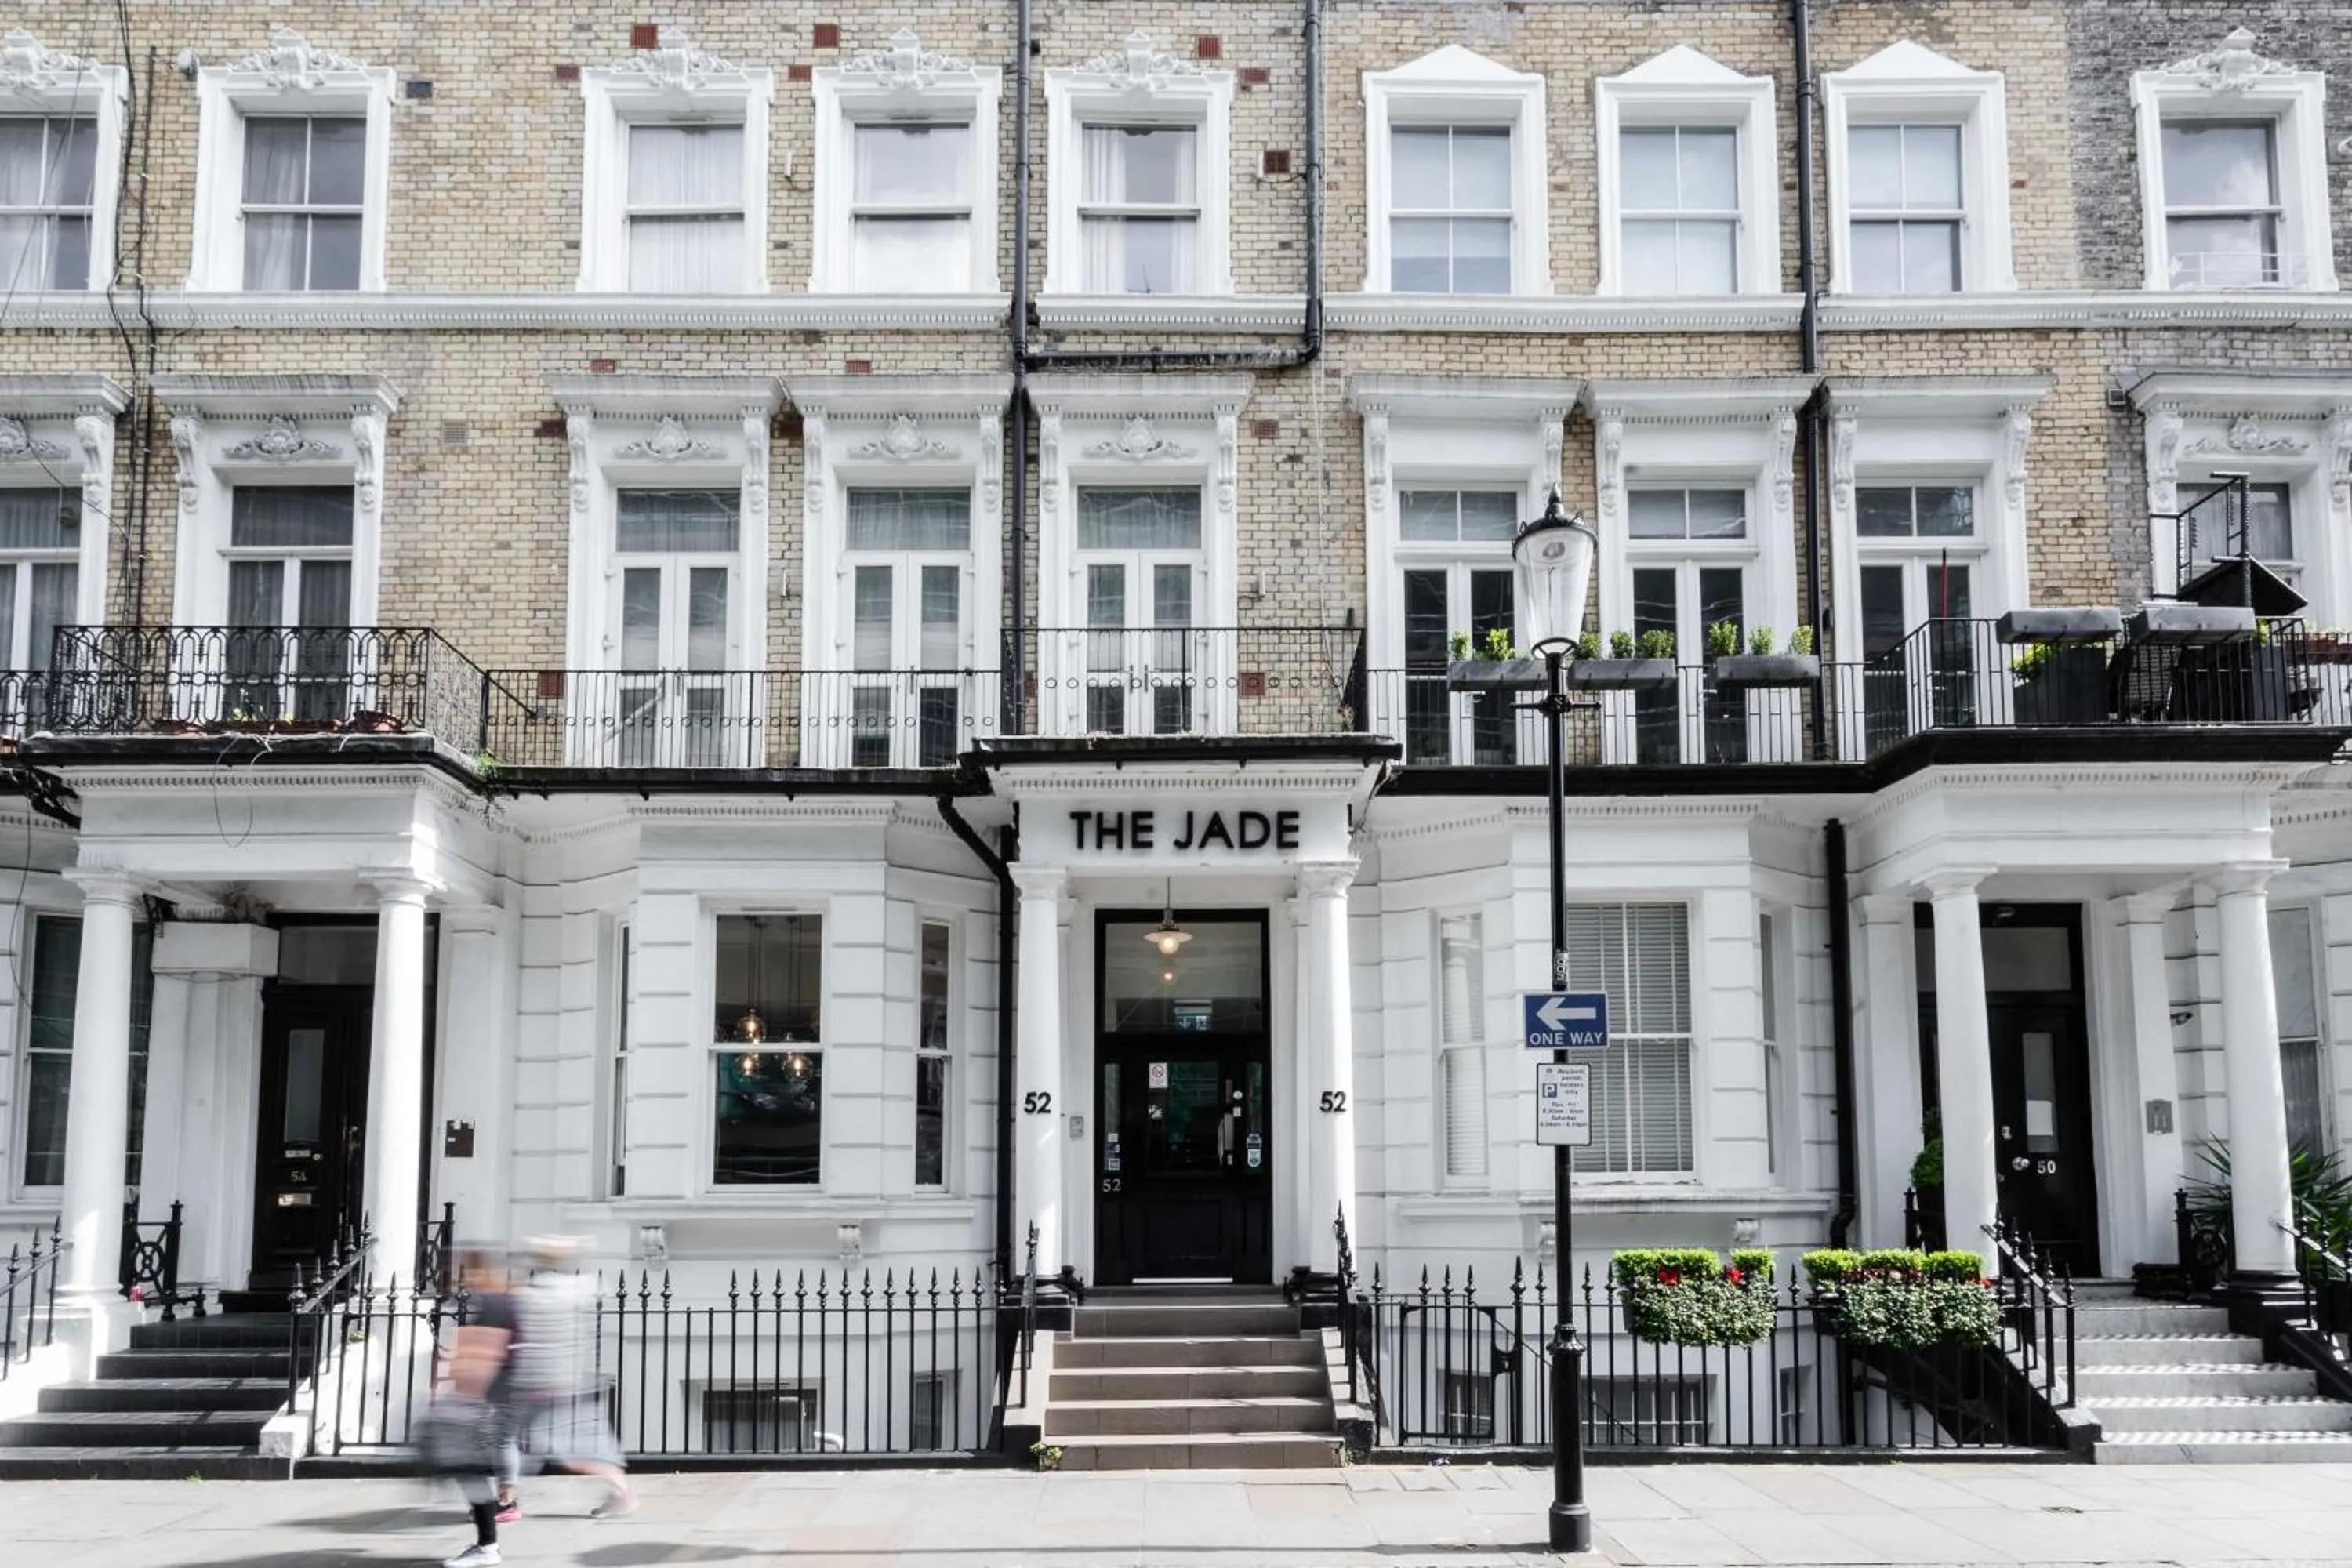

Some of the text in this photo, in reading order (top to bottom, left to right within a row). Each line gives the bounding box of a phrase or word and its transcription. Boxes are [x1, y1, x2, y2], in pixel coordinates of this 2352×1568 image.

[1069, 811, 1299, 850] THE JADE
[1530, 1031, 1604, 1045] ONE WAY
[1544, 1084, 1555, 1097] P
[1023, 1091, 1051, 1113] 52
[1319, 1091, 1347, 1113] 52
[2037, 1160, 2056, 1174] 50
[1102, 1178, 1122, 1192] 52
